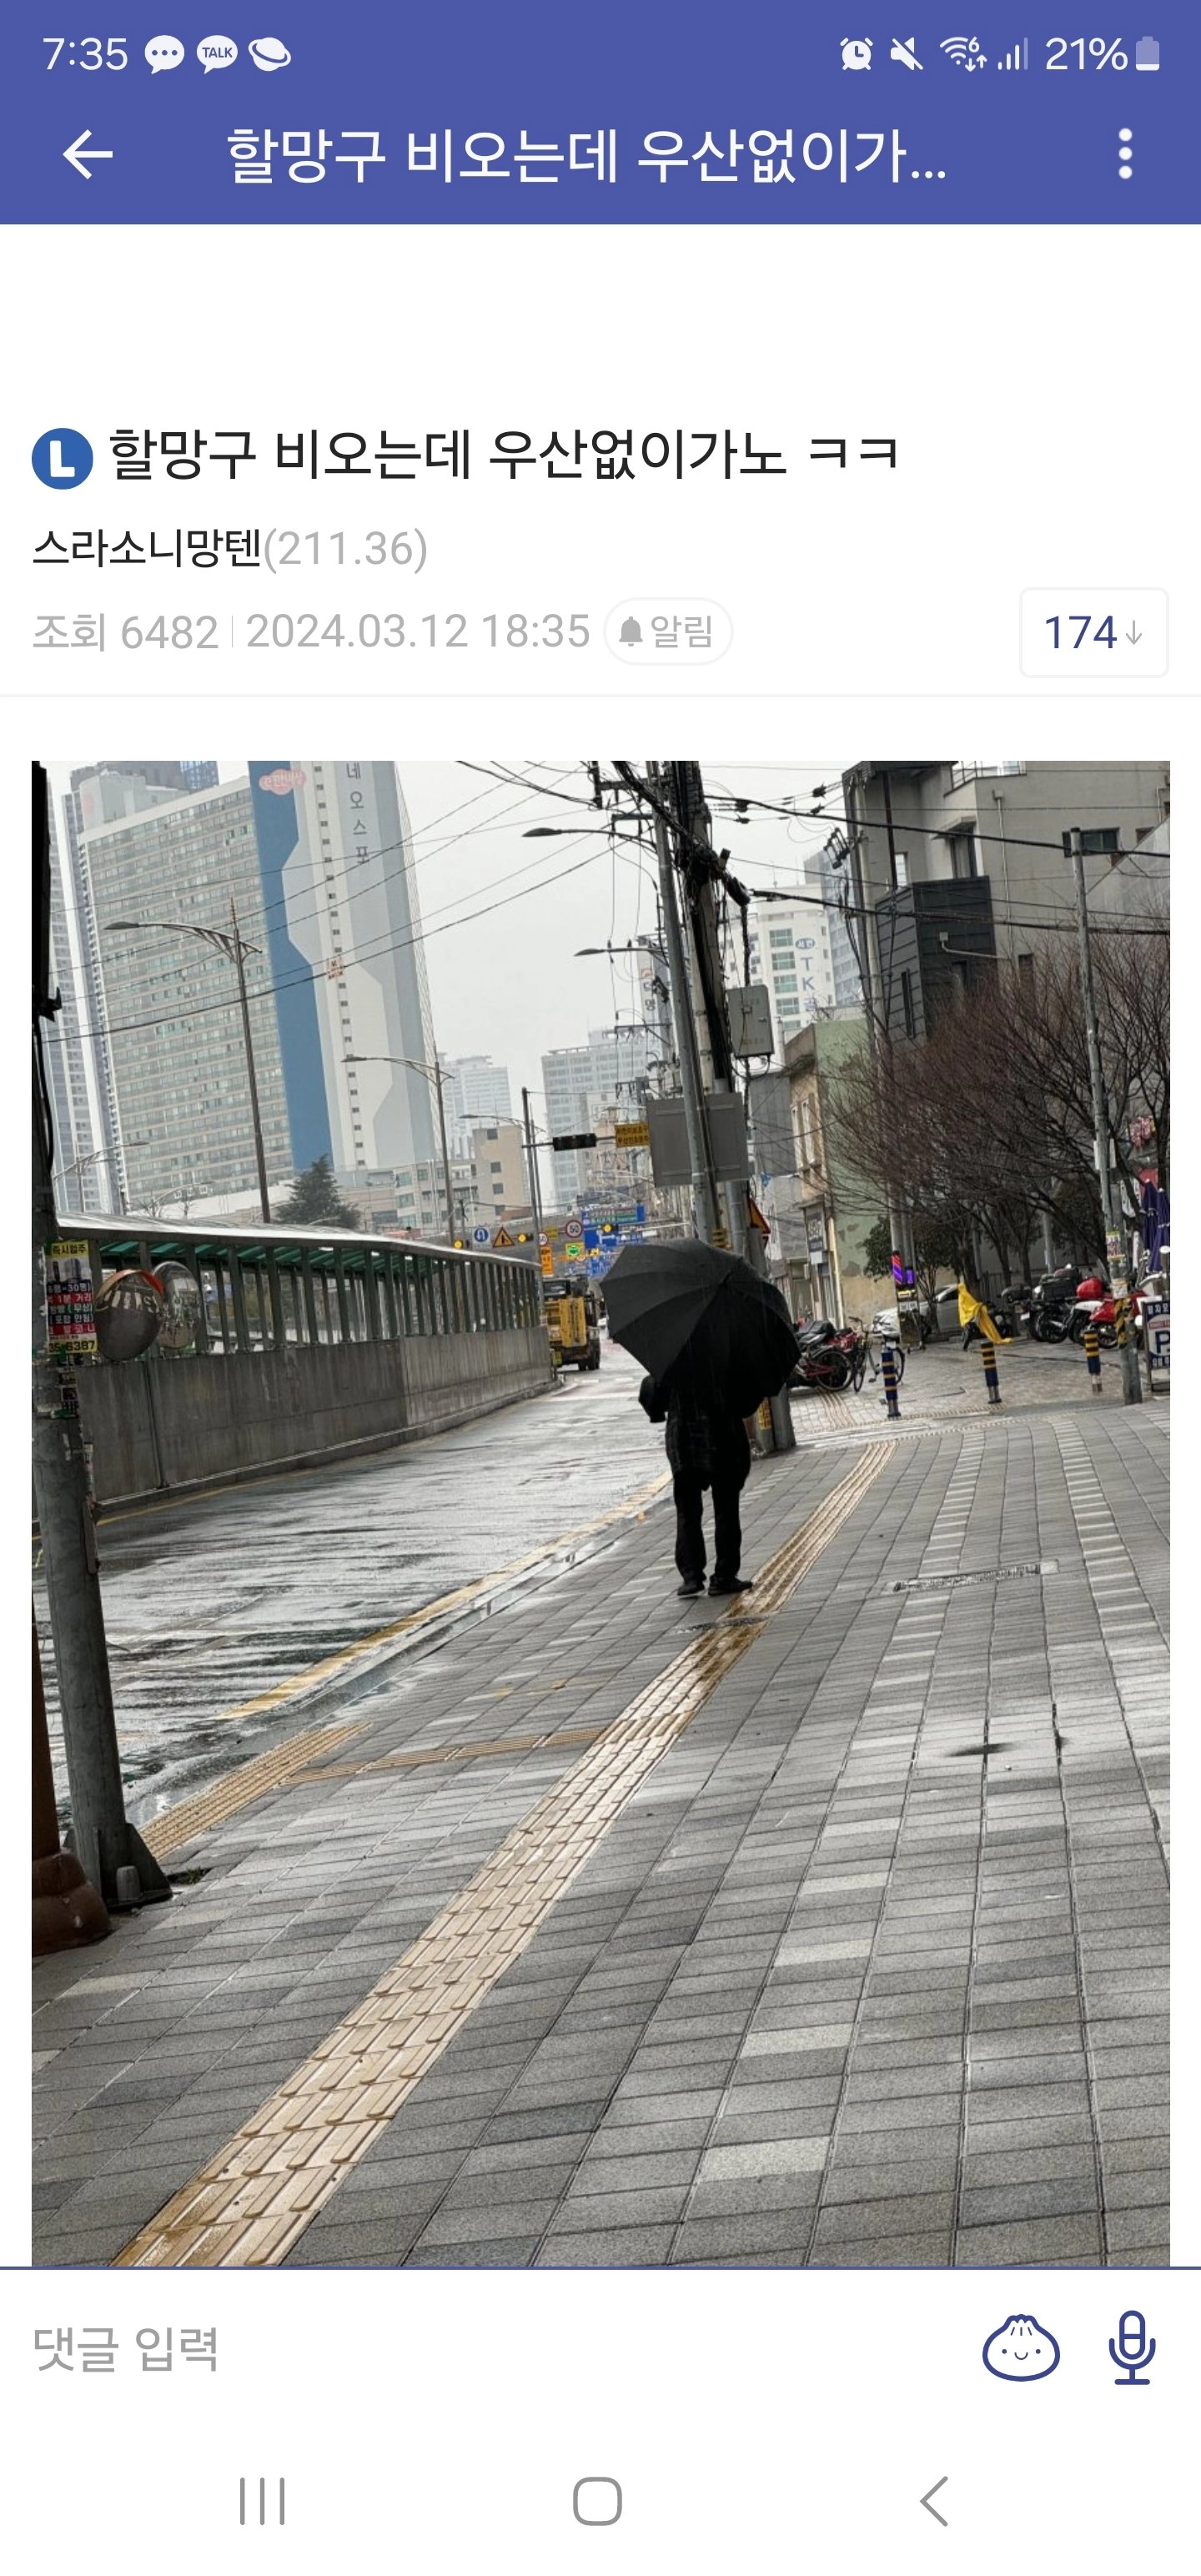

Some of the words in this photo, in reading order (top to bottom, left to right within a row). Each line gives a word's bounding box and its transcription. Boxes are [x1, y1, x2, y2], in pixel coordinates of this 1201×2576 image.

[43, 37, 128, 71] 7:35
[202, 47, 233, 58] TALK
[1045, 37, 1128, 71] 21%
[227, 128, 386, 184] 할망구
[408, 128, 616, 184] 비오는데
[49, 440, 76, 478] L
[109, 429, 257, 480] 할망구
[277, 429, 470, 480] 비오는데
[489, 429, 787, 480] 우산없이가노
[809, 438, 897, 469] ㅋㅋ
[33, 612, 105, 652] 조회
[122, 615, 219, 650] 6482
[246, 613, 468, 648] 2024.03.12
[482, 613, 590, 648] 18:35
[651, 615, 711, 648] 알림
[1045, 615, 1118, 649] 174
[34, 2327, 119, 2373] 댓글
[135, 2327, 217, 2372] 입력
